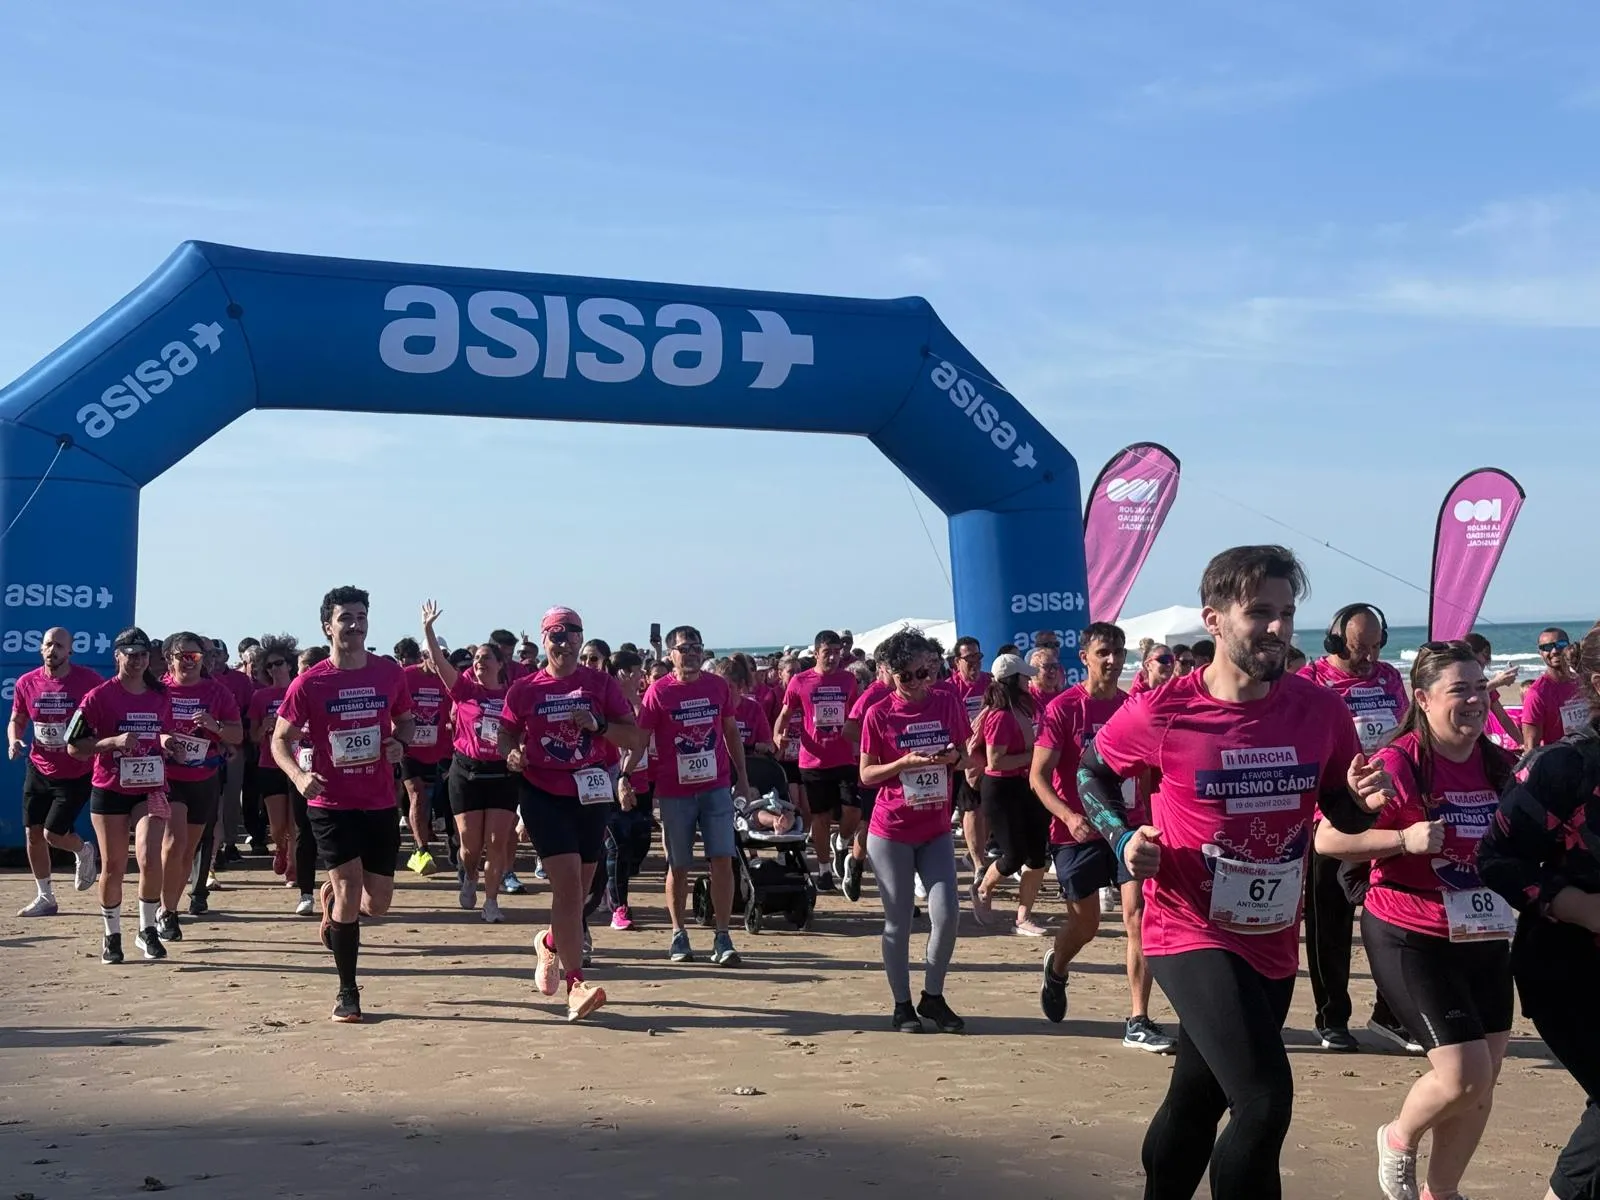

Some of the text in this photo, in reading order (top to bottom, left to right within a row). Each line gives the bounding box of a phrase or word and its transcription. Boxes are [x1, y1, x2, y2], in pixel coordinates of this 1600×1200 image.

[379, 284, 723, 387] asisa
[76, 340, 198, 439] asisa
[930, 360, 1017, 450] asisa
[4, 583, 93, 608] asisa
[1011, 592, 1074, 613] asisa
[3, 630, 91, 653] asa
[330, 699, 386, 713] AUTISMO CÁDIZ
[537, 704, 570, 715] AUTISMO
[823, 707, 839, 716] 590
[40, 727, 58, 737] 643
[416, 729, 432, 737] 732
[1366, 722, 1384, 737] 92
[345, 734, 371, 749] 266
[900, 737, 932, 748] AUTISMO
[688, 757, 709, 770] 200
[1226, 750, 1294, 766] II MARCHA
[132, 762, 156, 775] 273
[1248, 770, 1273, 780] FAVOR
[1273, 768, 1284, 777] DE
[587, 775, 605, 787] 265
[916, 772, 939, 786] 428
[1204, 774, 1316, 796] AUTISMO CÁDIZ
[1255, 799, 1272, 808] abril
[1454, 791, 1496, 804] MARCHA
[1229, 865, 1269, 877] MARCHA
[1248, 878, 1283, 902] 67
[1236, 900, 1269, 909] ANTONIO
[1471, 892, 1495, 913] 68
